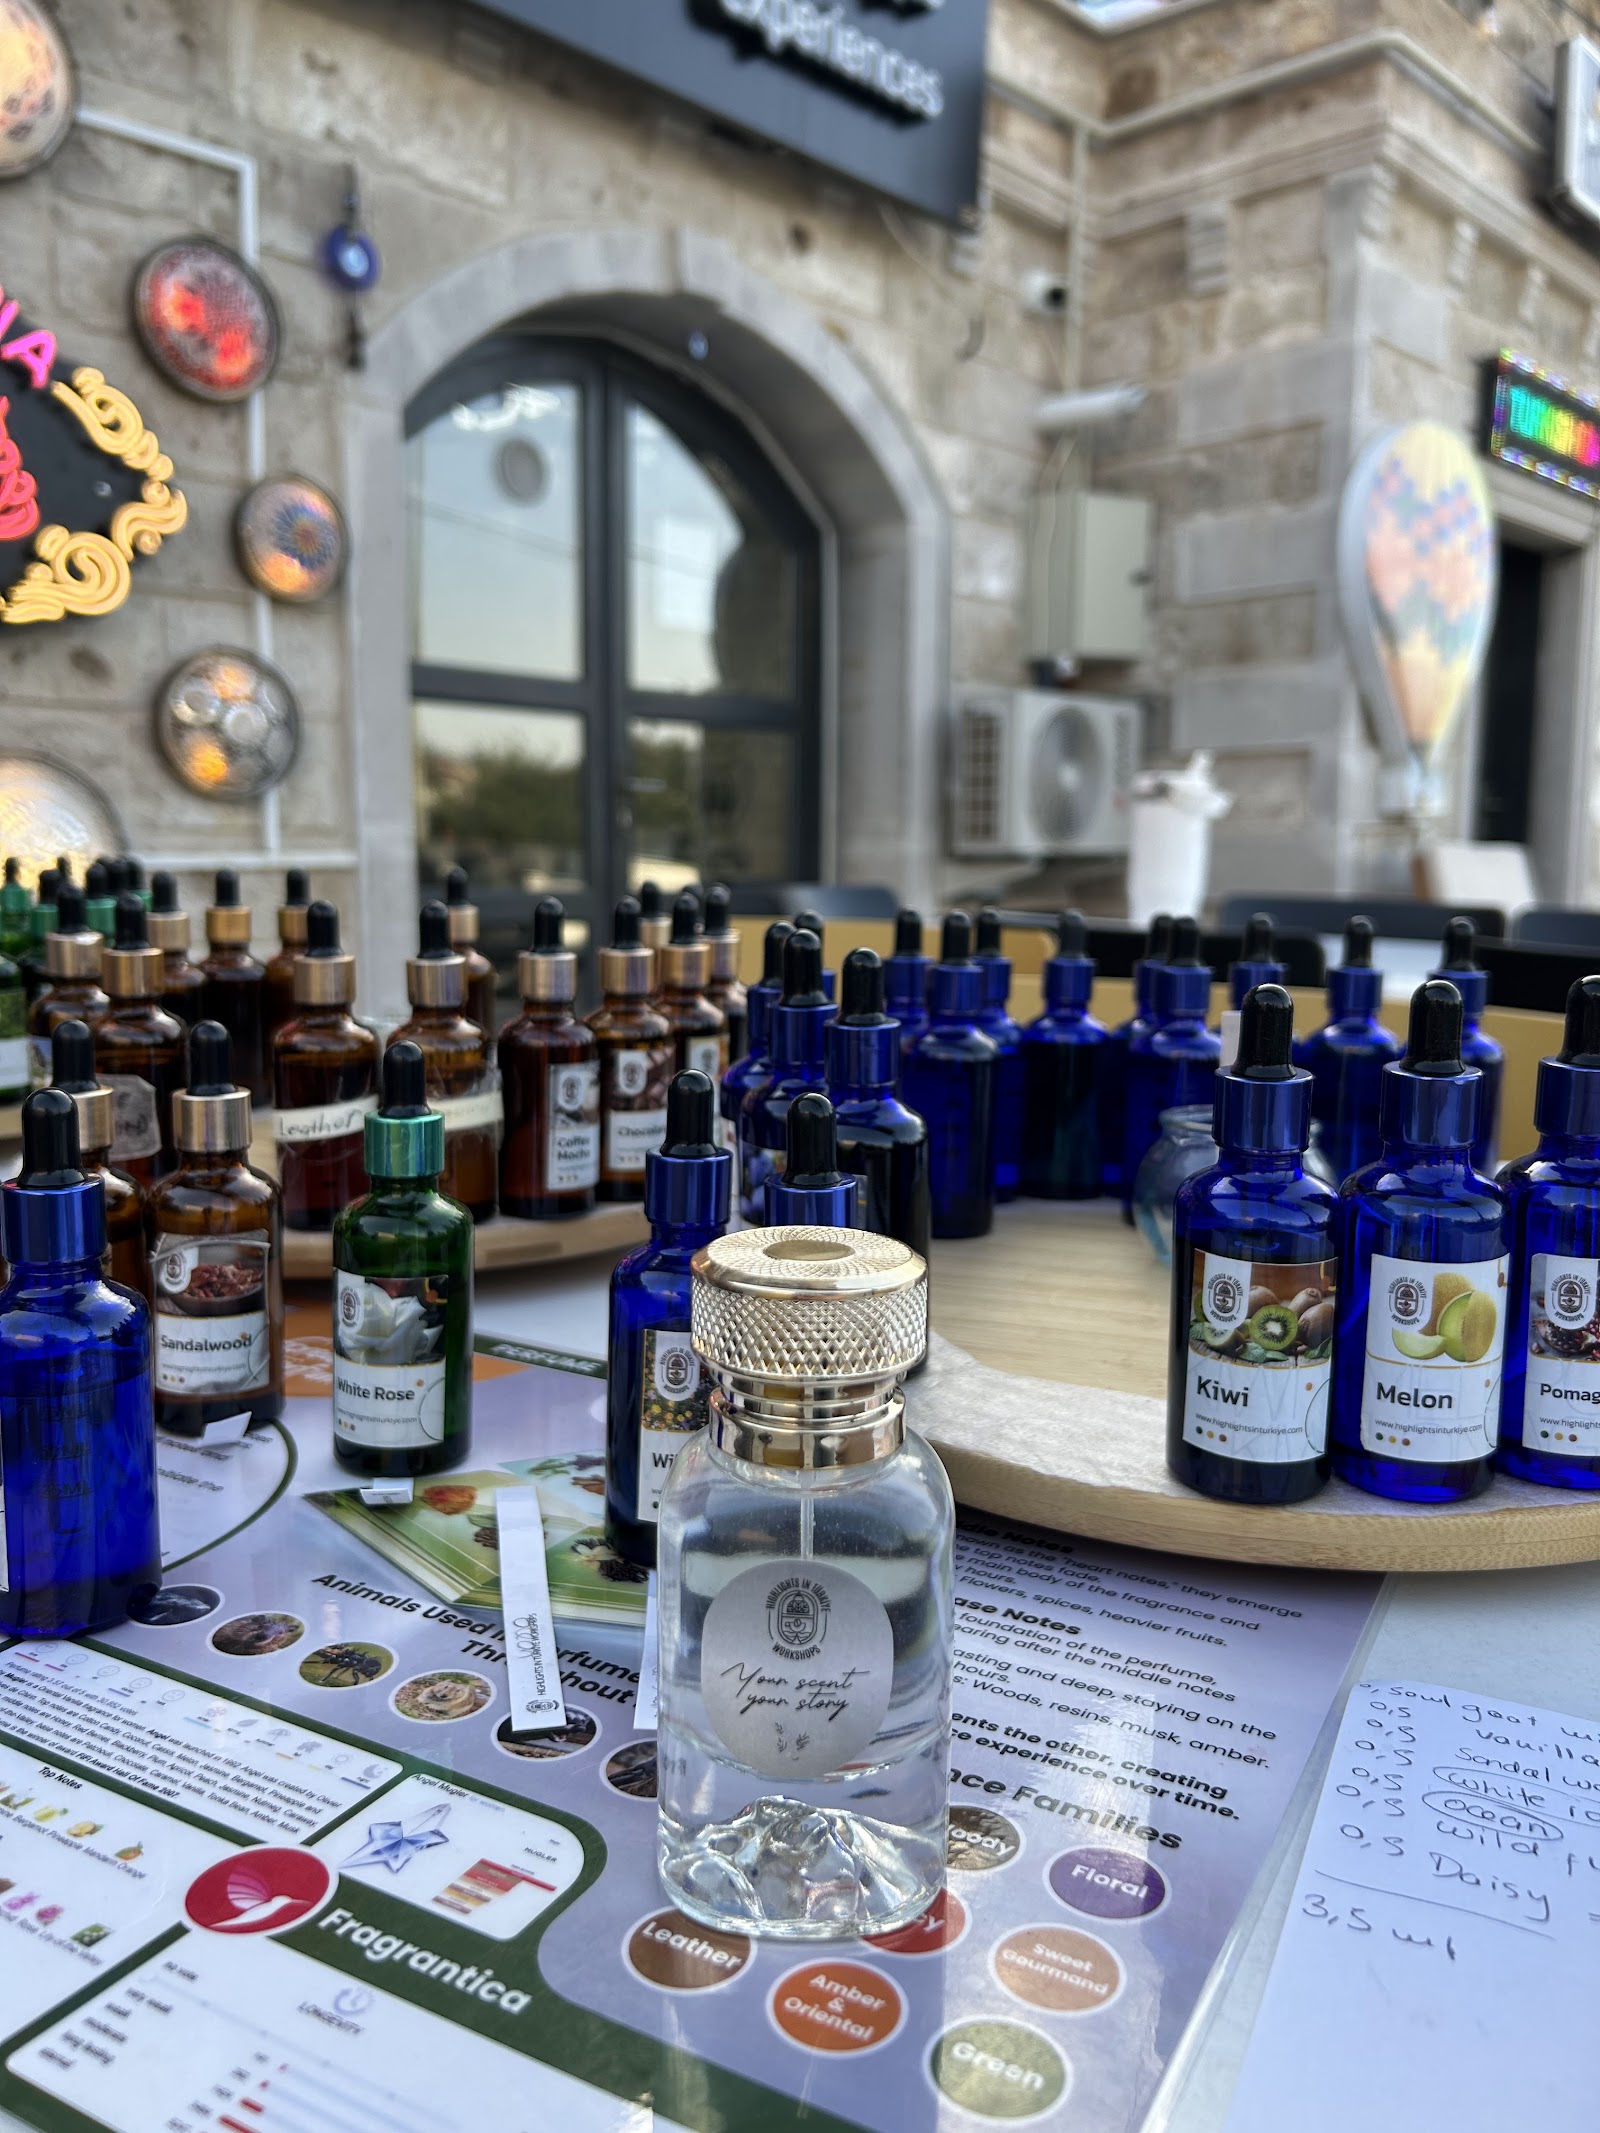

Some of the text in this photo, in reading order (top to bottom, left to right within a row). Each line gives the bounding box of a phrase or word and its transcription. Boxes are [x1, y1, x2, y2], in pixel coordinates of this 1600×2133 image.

[161, 1334, 253, 1351] Sandalwood
[336, 1376, 416, 1401] White Rose
[1196, 1375, 1250, 1407] Kiwi
[1376, 1382, 1453, 1409] Melon
[1195, 1412, 1303, 1435] www.highlightsinturkiye.com
[1375, 1418, 1483, 1435] www.highlightsinturkiye.com
[1001, 1531, 1073, 1554] Notes
[964, 1566, 1017, 1584] hours.
[974, 1547, 1102, 1583] top notes fade.
[1003, 1545, 1026, 1555] as
[1027, 1549, 1057, 1563] the
[1181, 1584, 1223, 1601] they
[1225, 1596, 1303, 1619] emerge
[312, 1573, 421, 1614] Animals
[422, 1605, 498, 1637] Used
[765, 1577, 800, 1609] HIGHLIGHTS
[801, 1578, 812, 1590] IN
[959, 1575, 1228, 1647] Flowers, spices, heavier fruits.
[967, 1557, 1261, 1631] main body of the fragrance and
[1001, 1607, 1083, 1636] Notes
[772, 1642, 821, 1661] WORKSHOPS
[959, 1612, 1218, 1686] foundation of the perfume,
[721, 1662, 871, 1698] Your scent
[953, 1660, 1012, 1684] hours.
[1013, 1638, 1237, 1703] after the middle notes
[740, 1686, 850, 1722] your story
[1016, 1664, 1058, 1682] and
[1060, 1677, 1117, 1700] deep,
[1122, 1692, 1202, 1723] staying
[1206, 1716, 1235, 1730] on
[1240, 1723, 1278, 1741] the
[973, 1679, 1271, 1769] Woods, resins, musk, amber.
[38, 1766, 83, 1790] Top Notes
[89, 1759, 116, 1772] Award
[112, 1767, 130, 1778] Hall
[137, 1778, 160, 1791] Fame
[147, 1728, 170, 1740] Angel
[241, 1765, 266, 1777] Angel
[278, 1780, 309, 1794] created
[975, 1736, 1240, 1820] experience over time.
[1004, 1725, 1043, 1744] the
[1045, 1739, 1115, 1767] other,
[1120, 1759, 1230, 1800] creating
[268, 1789, 306, 1808] Pineapple
[304, 1804, 324, 1815] and
[411, 1773, 442, 1788] Angel
[438, 1782, 470, 1798] Mugler
[277, 1820, 301, 1834] Musk
[1012, 1785, 1183, 1849] Families
[1443, 1798, 1549, 1837] ocean
[524, 1846, 558, 1863] MUGLER
[1071, 1864, 1150, 1899] Floral
[1428, 1851, 1551, 1923] Daisy
[1302, 1893, 1372, 1932] 3,5
[317, 1907, 534, 2015] Fragrantica
[641, 1920, 744, 1969] Leather
[1032, 1942, 1096, 1972] Sweet
[1001, 1948, 1111, 1996] Gourmand
[809, 1973, 887, 2011] Amber
[827, 1996, 846, 2013] &
[783, 1996, 876, 2042] Oriental
[952, 2041, 1046, 2091] Green
